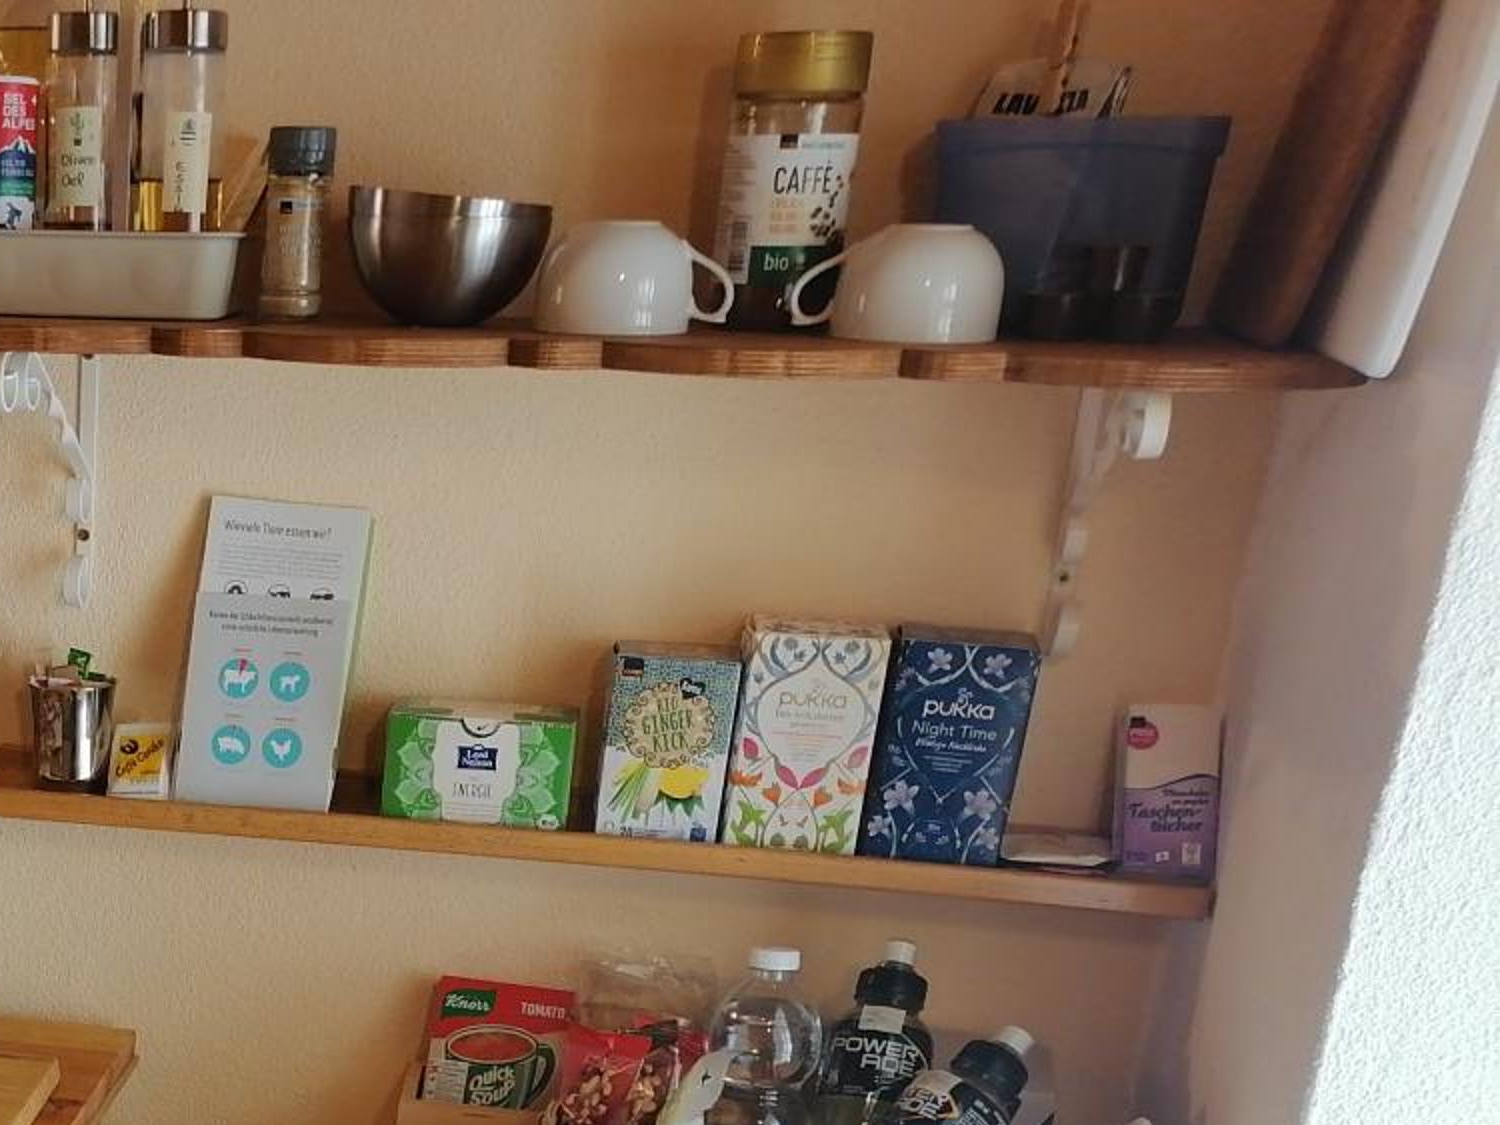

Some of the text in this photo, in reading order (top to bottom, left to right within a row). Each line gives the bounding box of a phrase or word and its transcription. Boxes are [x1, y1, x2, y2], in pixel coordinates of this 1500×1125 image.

[3, 92, 27, 105] SEL
[3, 105, 28, 117] DES
[763, 252, 790, 272] bio
[779, 688, 848, 710] pukka
[921, 698, 997, 721] pukka
[641, 709, 693, 736] GINGER
[911, 719, 998, 741] Night Time
[652, 732, 690, 753] KICK
[467, 750, 490, 759] Lord
[444, 993, 566, 1019] Knorr TOMATO
[833, 1036, 920, 1060] POWER
[860, 1053, 916, 1078] ADE
[469, 1065, 516, 1091] Quick
